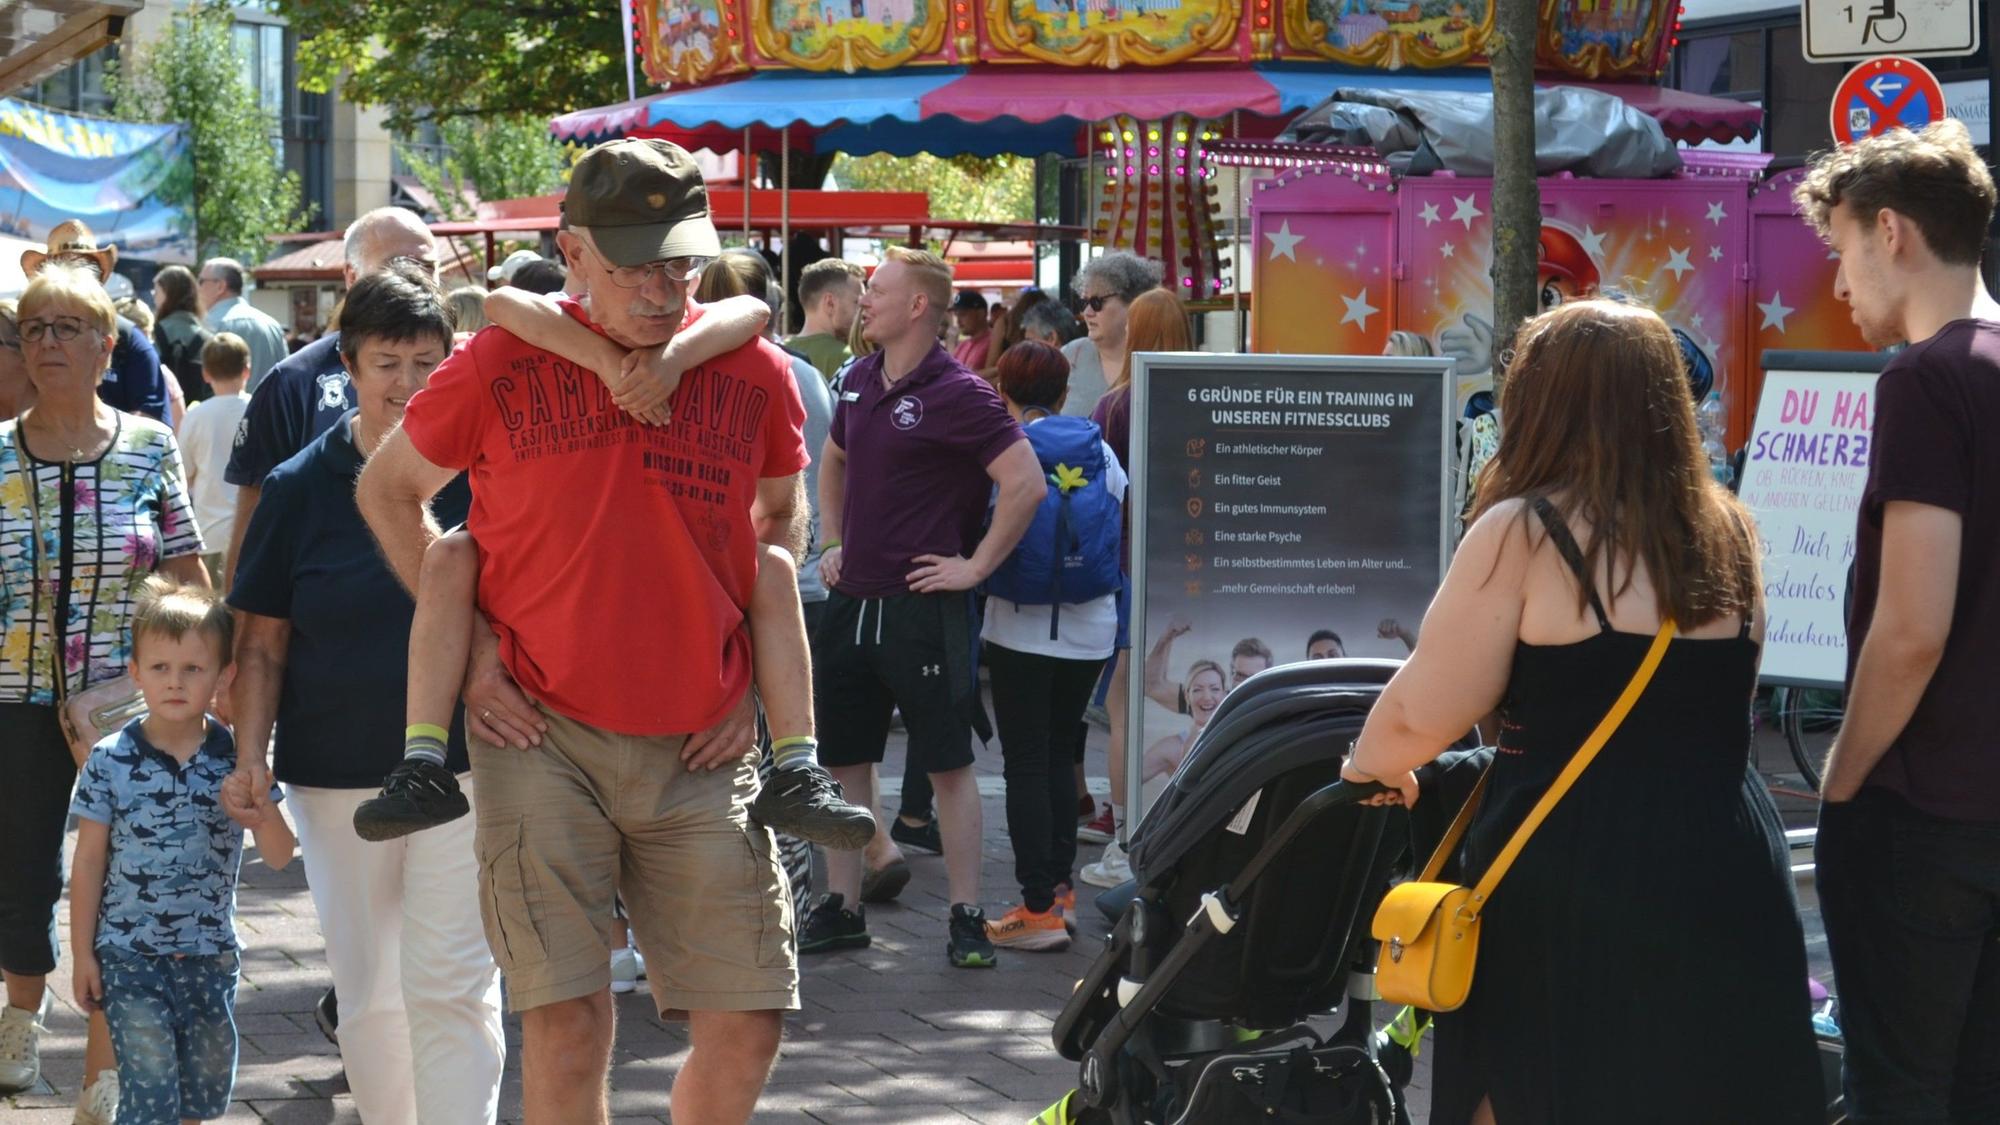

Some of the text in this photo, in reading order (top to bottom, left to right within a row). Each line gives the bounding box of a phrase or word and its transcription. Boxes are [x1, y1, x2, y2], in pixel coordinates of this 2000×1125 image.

[1843, 5, 1852, 23] 1
[671, 365, 769, 443] AVID
[1188, 386, 1414, 407] 6 GRÜNDE FÜR EIN TRAINING IN
[1211, 410, 1391, 428] UNSEREN FITNESSCLUBS
[1780, 389, 1873, 432] DU HA
[1215, 443, 1323, 457] Ein athletischer Körper
[1752, 431, 1871, 467] SCHMERZ
[643, 450, 693, 477] MISSION
[1215, 474, 1282, 486] Ein fitter Geist
[1215, 502, 1327, 517] Ein gutes Immunsystem
[1215, 531, 1302, 544] Eine starke Psyche
[1792, 525, 1830, 560] Dich
[1214, 557, 1412, 570] Ein selbstbestimmtes Leben im Alter und...
[1213, 583, 1356, 595] ...mehr Gemeinschaft erleben!
[1765, 570, 1836, 601] ostenlos
